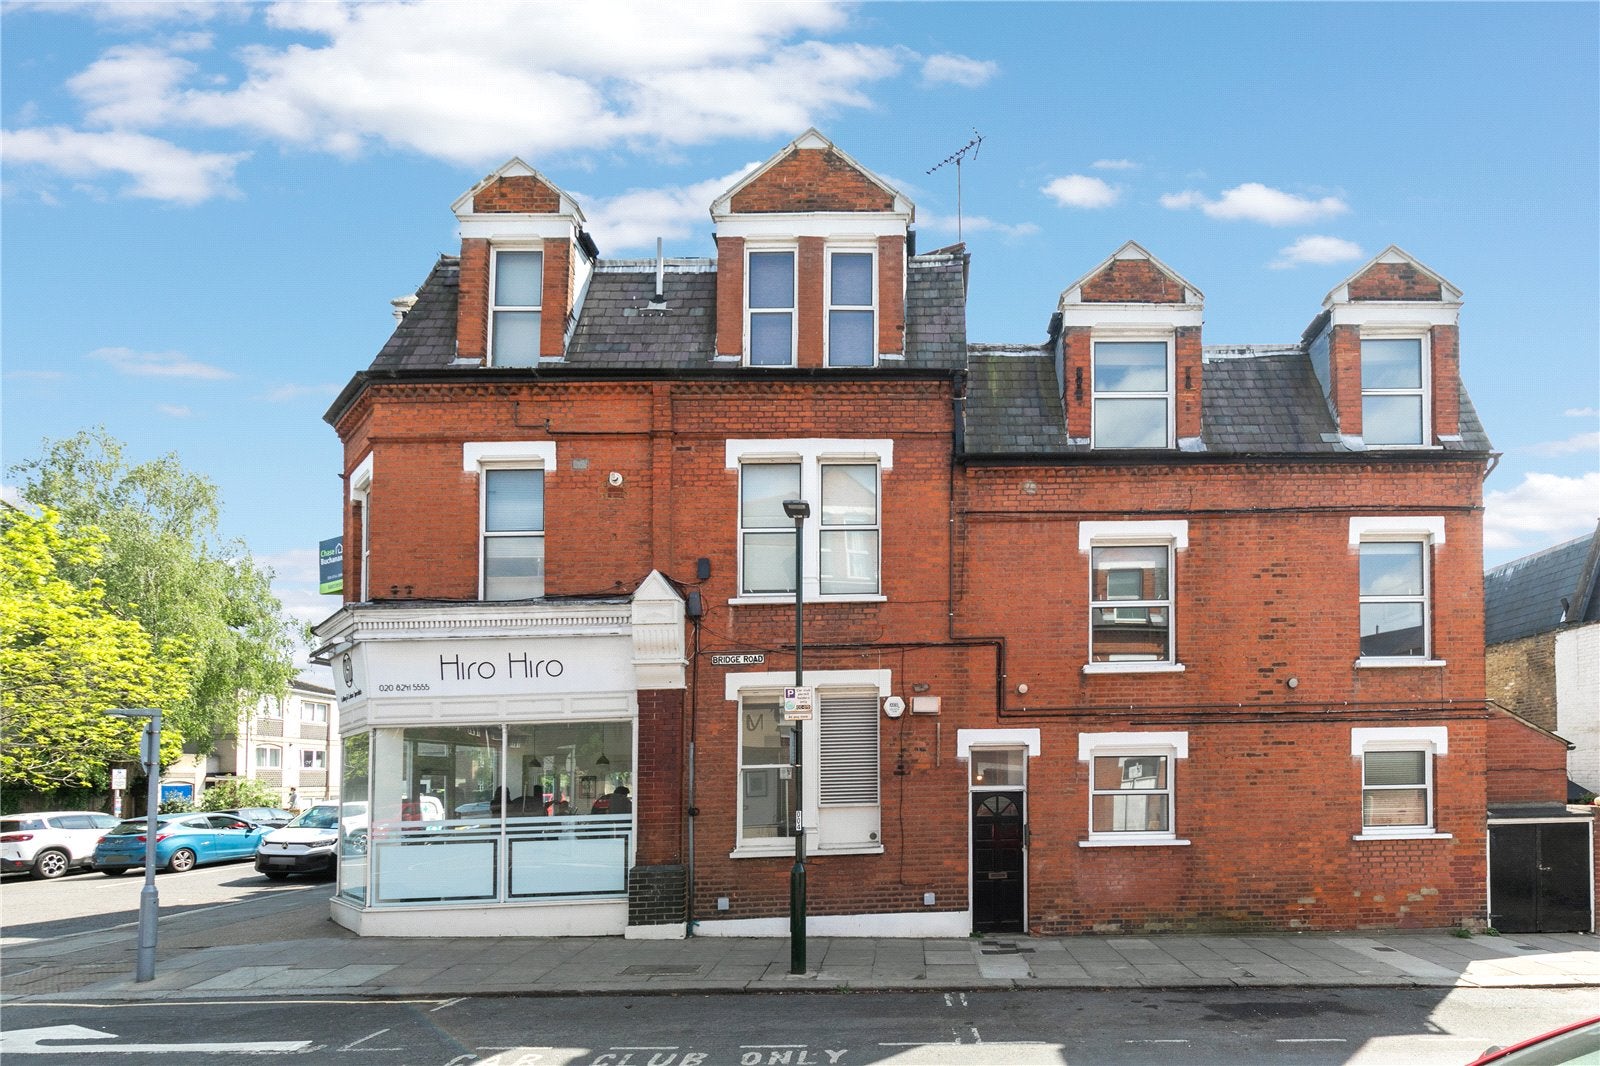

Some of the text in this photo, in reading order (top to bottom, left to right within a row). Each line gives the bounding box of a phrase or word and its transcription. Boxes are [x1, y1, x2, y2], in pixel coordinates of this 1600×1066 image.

[712, 655, 764, 664] BRIDGE ROAD
[378, 684, 394, 692] 020
[412, 683, 430, 691] 5555
[740, 1049, 849, 1066] ONLY
